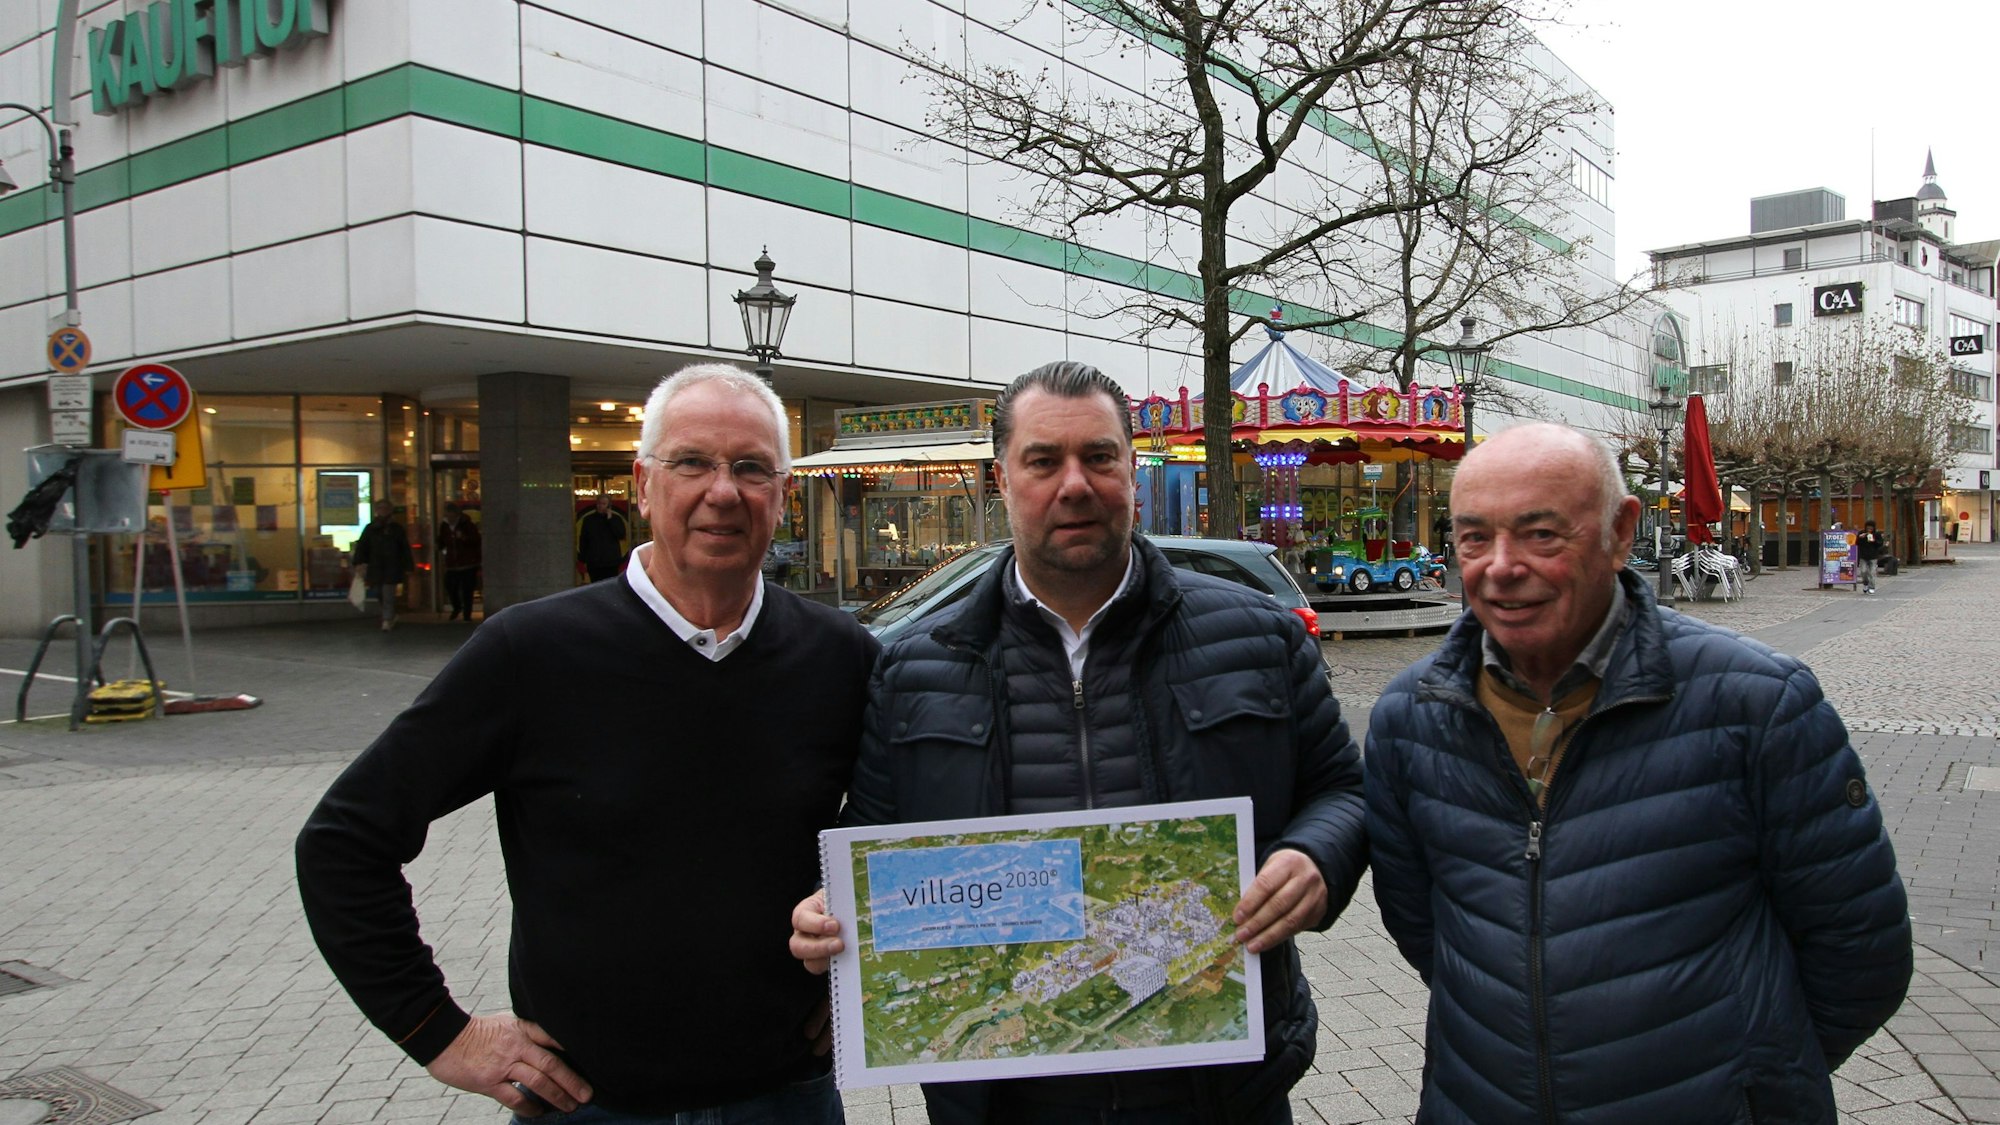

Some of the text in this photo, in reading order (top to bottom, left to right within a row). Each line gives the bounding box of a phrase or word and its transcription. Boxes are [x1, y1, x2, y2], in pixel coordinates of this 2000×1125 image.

[1819, 288, 1856, 310] C&A
[1954, 339, 1979, 353] C&A
[902, 879, 1002, 909] village
